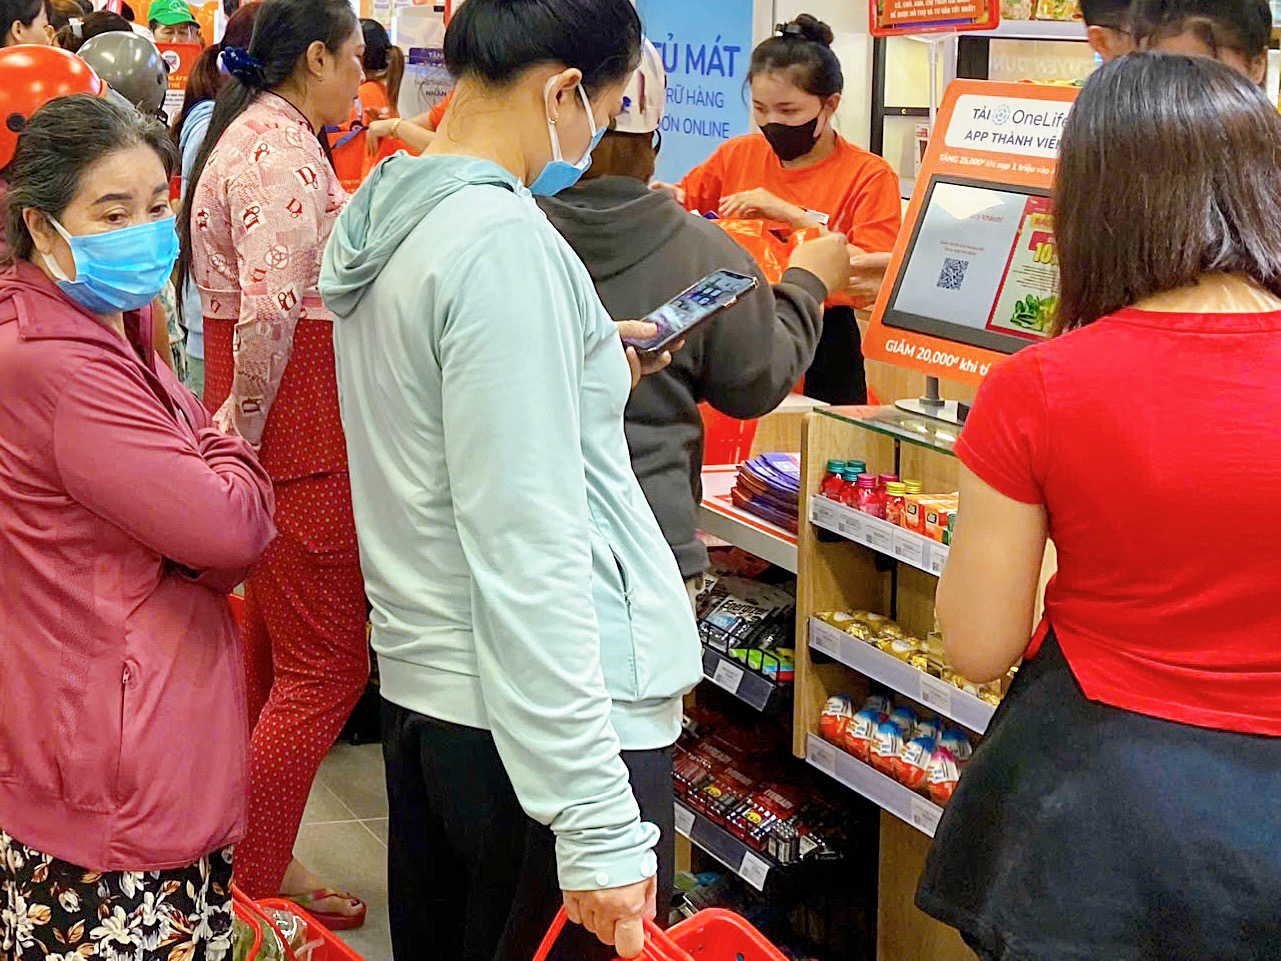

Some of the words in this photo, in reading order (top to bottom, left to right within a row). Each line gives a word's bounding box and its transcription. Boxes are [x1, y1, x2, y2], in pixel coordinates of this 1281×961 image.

[685, 35, 741, 77] MÁT
[666, 84, 685, 104] RỮ
[686, 85, 724, 108] HÀNG
[973, 105, 991, 120] TẢI
[1012, 109, 1067, 127] OneLife
[683, 118, 730, 139] ONLINE
[965, 130, 988, 142] APP
[992, 131, 1033, 147] THÀNH
[885, 339, 916, 358] GIẢM
[959, 357, 979, 373] khi
